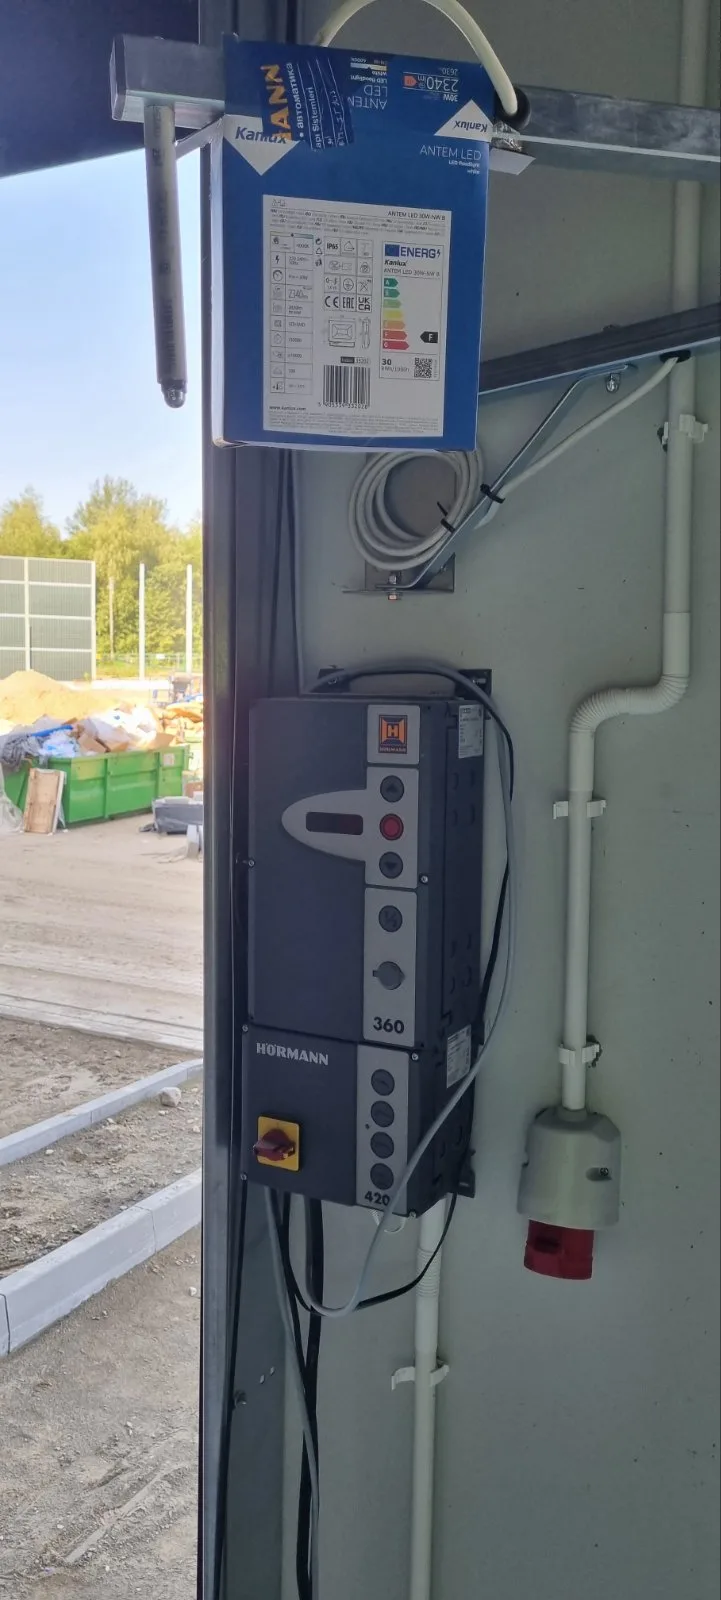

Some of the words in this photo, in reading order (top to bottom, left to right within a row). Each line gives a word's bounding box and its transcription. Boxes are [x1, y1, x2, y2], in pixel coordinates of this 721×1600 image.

[363, 84, 388, 96] LED
[426, 76, 459, 92] 2340
[285, 62, 304, 129] автоматика
[306, 86, 321, 132] Sistemleri
[452, 119, 488, 134] Kanlux
[419, 144, 458, 159] ANTEM
[460, 148, 482, 161] LED
[387, 210, 407, 218] ANTEM
[384, 259, 407, 267] Kanlux
[428, 333, 434, 342] F
[387, 724, 399, 738] H
[372, 1016, 405, 1035] 360
[255, 1042, 330, 1067] HÖRMANN
[364, 1190, 391, 1207] 420
